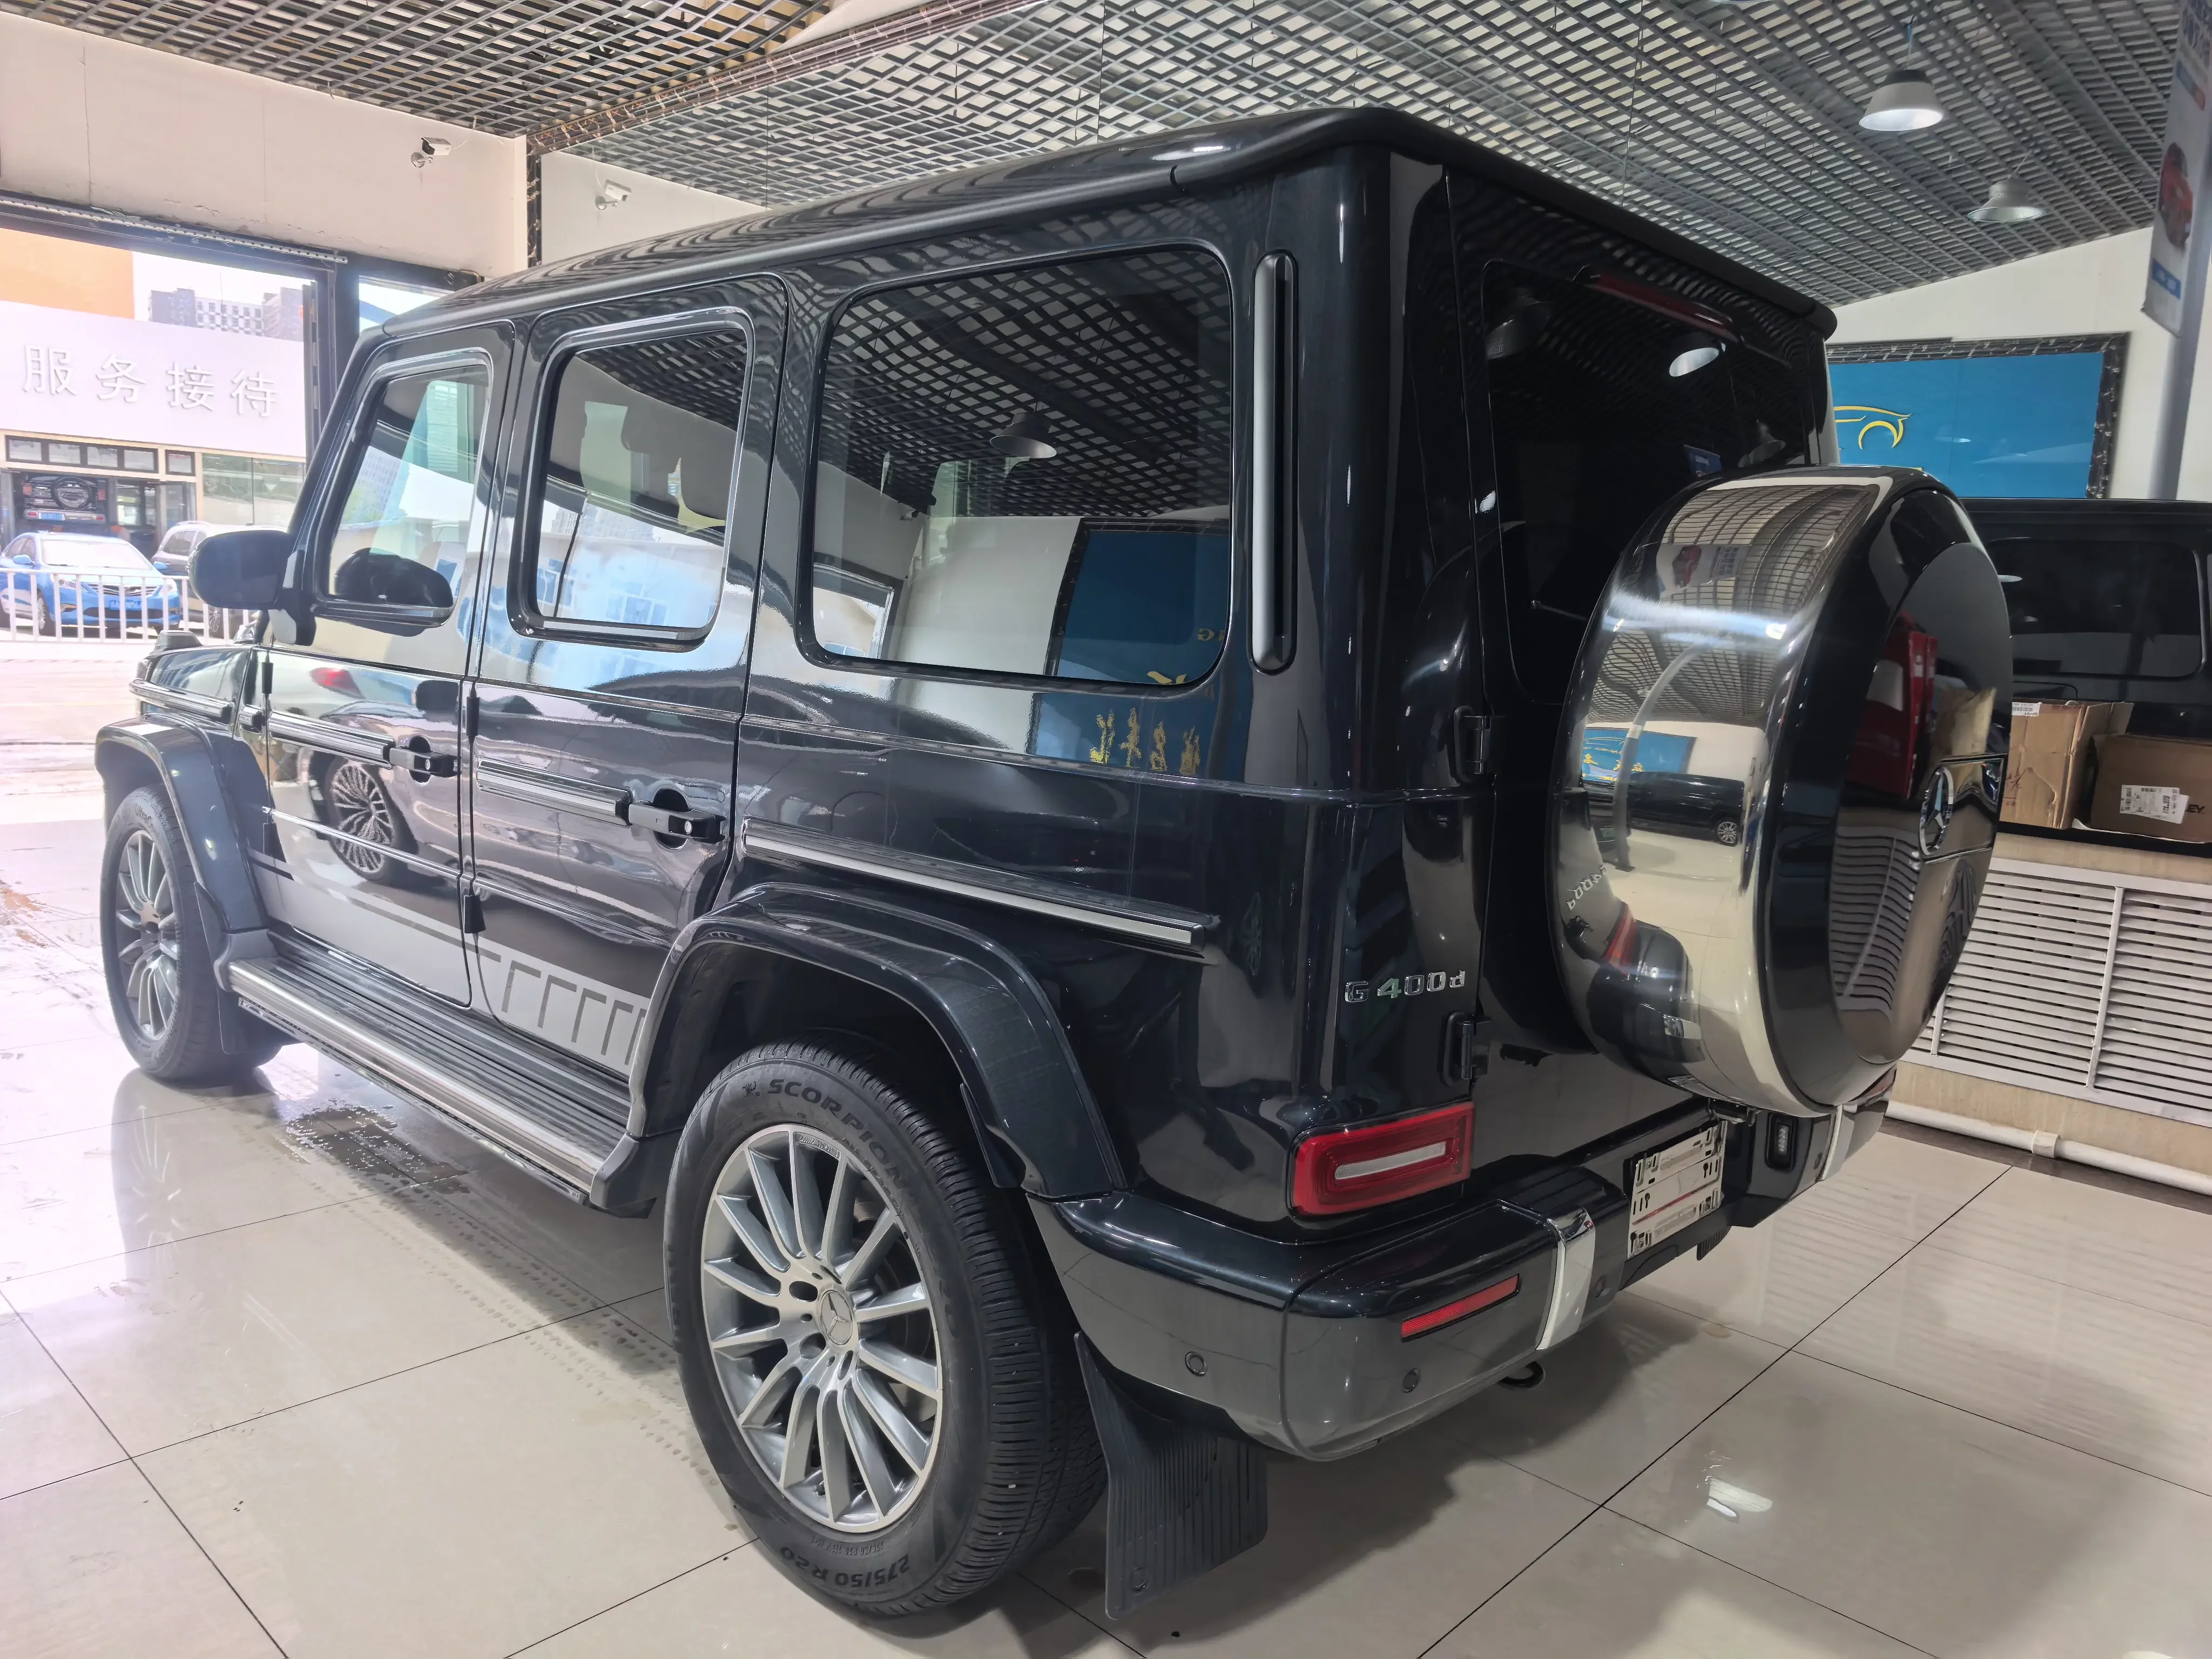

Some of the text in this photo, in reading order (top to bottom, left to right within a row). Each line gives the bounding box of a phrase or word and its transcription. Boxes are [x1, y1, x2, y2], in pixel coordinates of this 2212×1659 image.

[22, 344, 278, 418] 服务接待
[1345, 970, 1466, 1003] G 400d
[767, 1078, 909, 1190] SCORPION
[834, 1553, 911, 1588] 275/50
